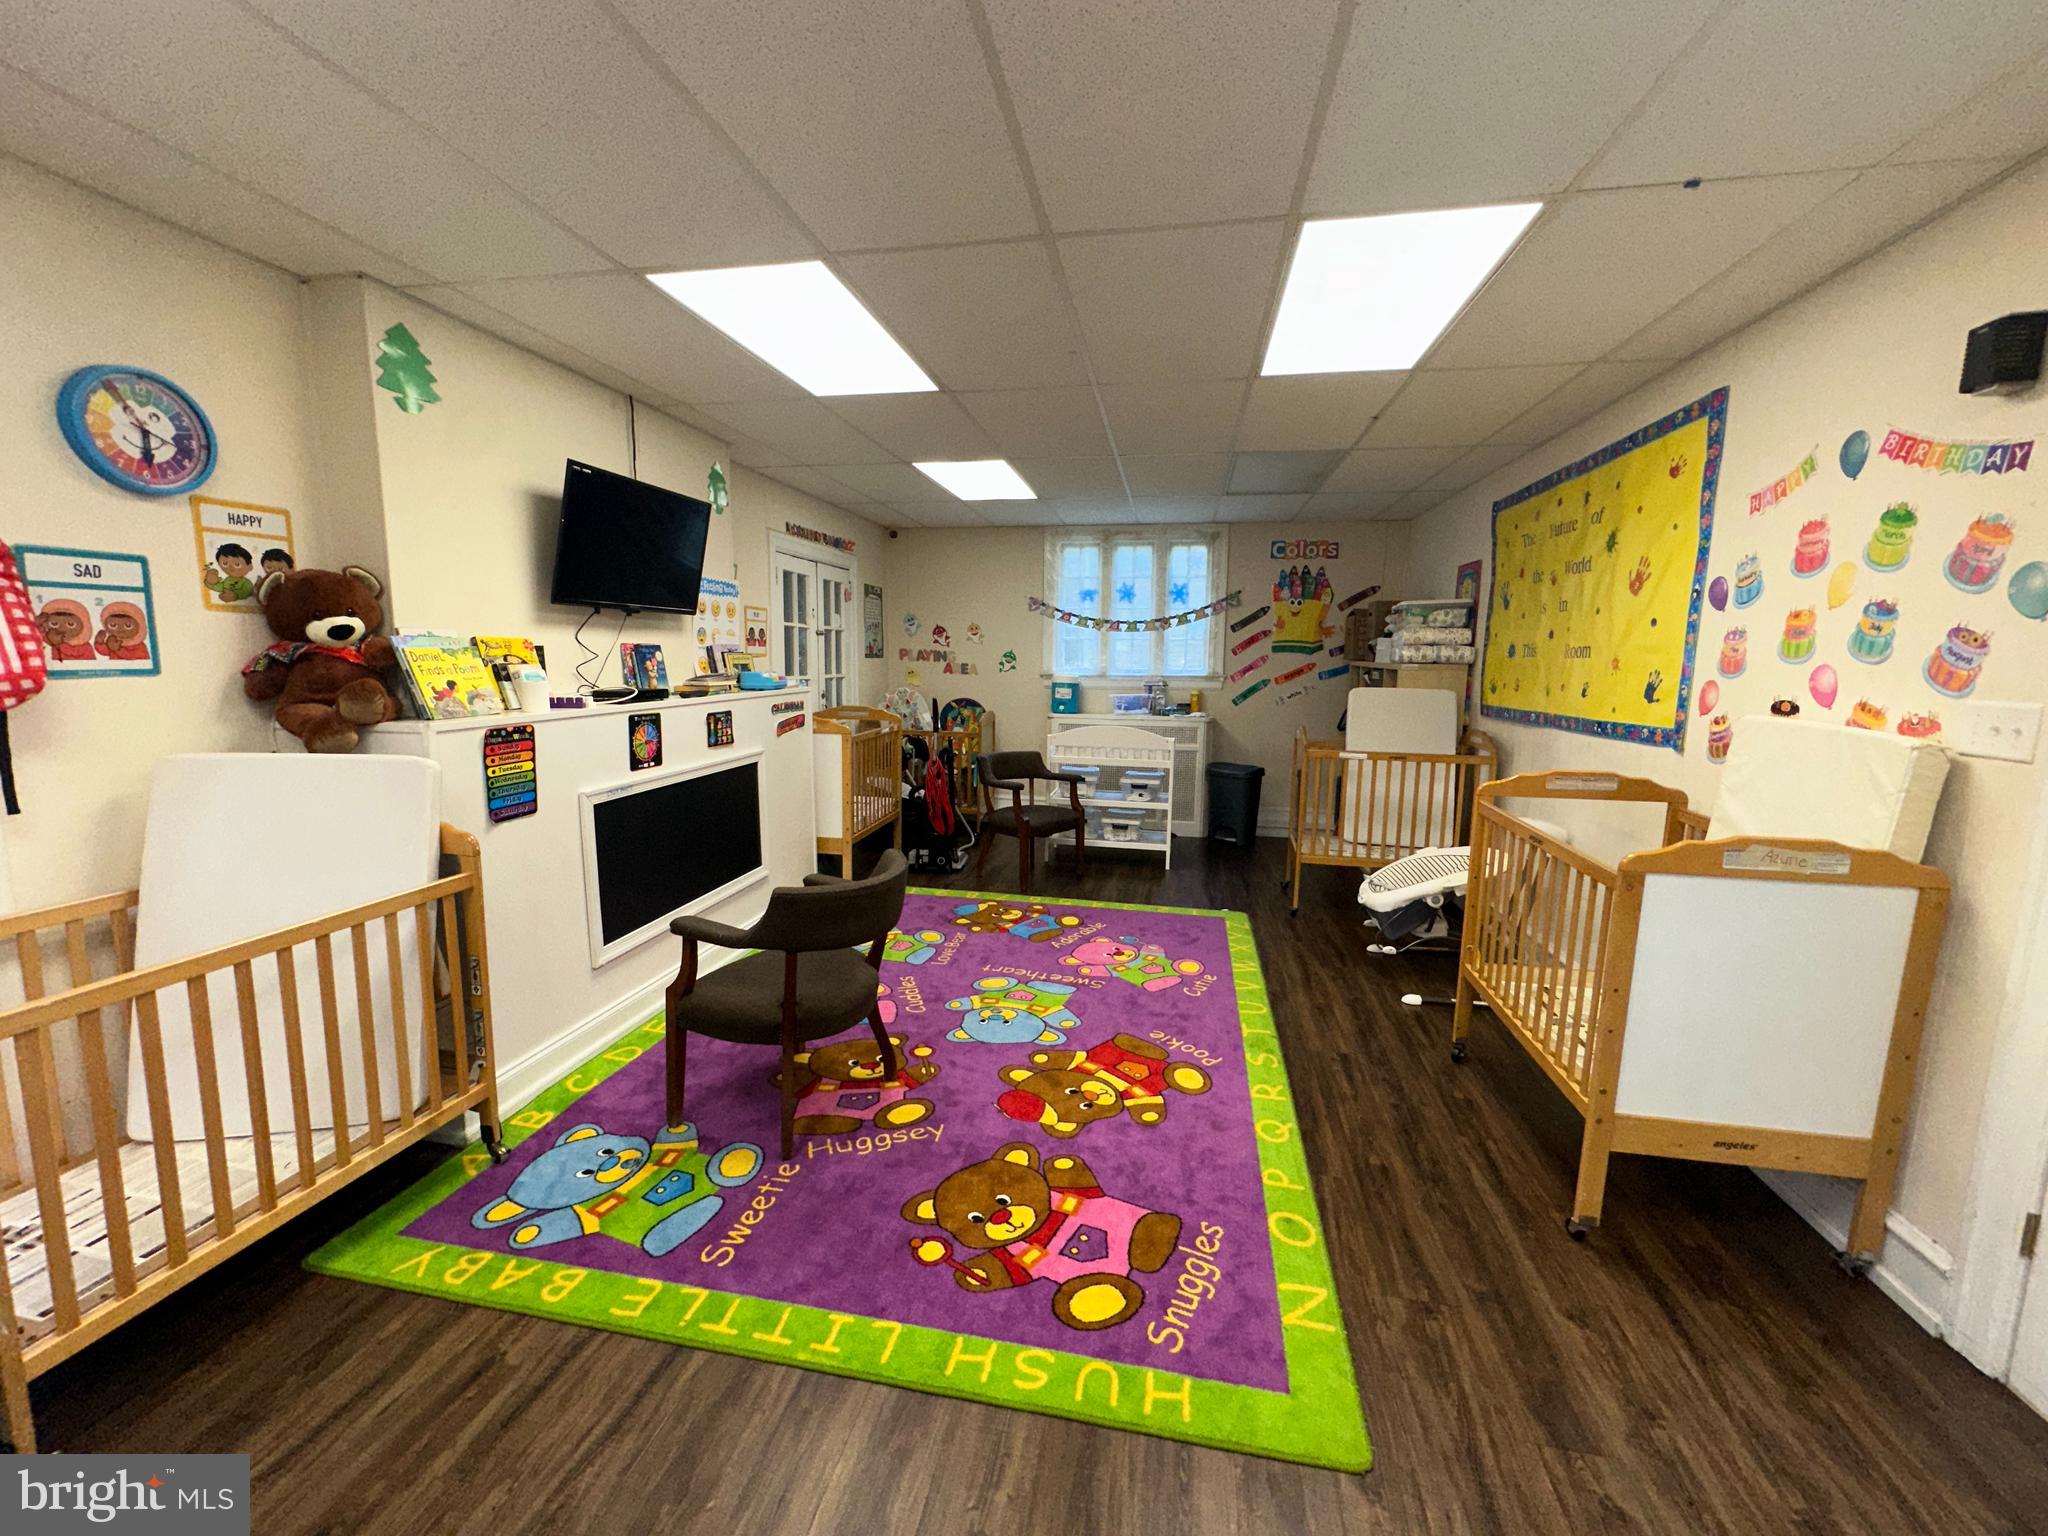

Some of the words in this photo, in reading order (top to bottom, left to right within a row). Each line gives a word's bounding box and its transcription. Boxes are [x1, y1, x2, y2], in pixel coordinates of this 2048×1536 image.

[1882, 432, 2030, 468] BIRTHDAY
[143, 470, 151, 479] 6
[167, 470, 175, 480] 5
[1750, 455, 1813, 513] HAPPY
[227, 512, 262, 529] HAPPY
[1522, 533, 1536, 548] The
[1550, 519, 1578, 539] Future
[1591, 506, 1606, 525] of
[1272, 541, 1338, 559] Colors
[73, 563, 102, 578] SAD
[1532, 570, 1545, 584] the
[1565, 556, 1593, 574] World
[1559, 599, 1568, 612] in
[1868, 622, 1883, 633] July
[899, 648, 957, 663] PLAYING
[1522, 644, 1537, 658] This
[1564, 644, 1591, 659] Room
[1946, 646, 1975, 666] August
[452, 663, 481, 675] Poem
[943, 662, 979, 676] AREA
[498, 764, 523, 773] Tuesday
[499, 753, 522, 762] Monday
[494, 773, 528, 784] Wednesday
[1051, 922, 1107, 949] Adorable
[982, 964, 1106, 990] Sweetheart
[1183, 974, 1217, 997] Cutie
[897, 975, 926, 1014] Cuddles
[1150, 1030, 1223, 1067] Pookie
[509, 1111, 554, 1129] B
[565, 1075, 598, 1092] C
[601, 1046, 643, 1063] D
[807, 1123, 944, 1160] Huggsey
[700, 1162, 800, 1268] Sweetie
[390, 1246, 588, 1304] BABY
[1148, 1221, 1224, 1353] Snuggles
[609, 1277, 902, 1364] LITTLE
[944, 1337, 1192, 1422] HUSH
